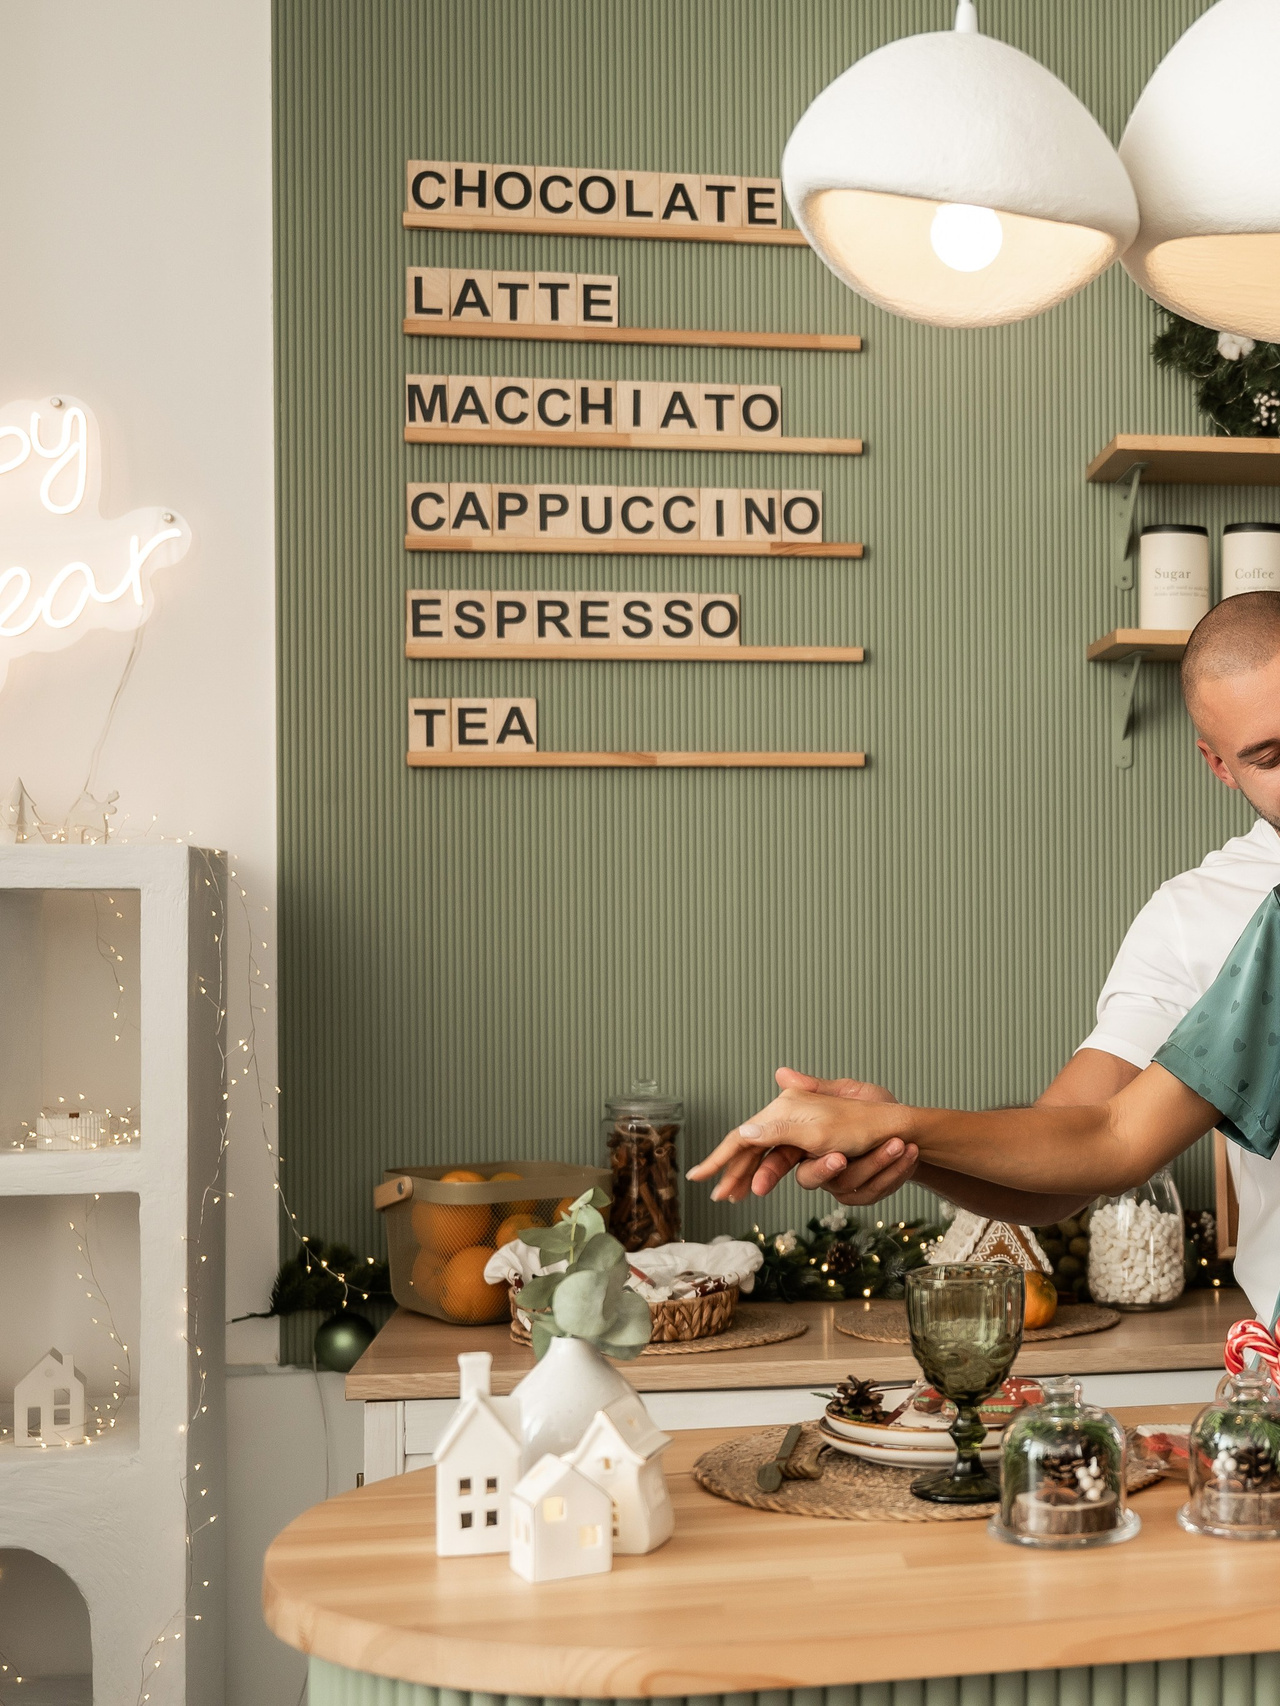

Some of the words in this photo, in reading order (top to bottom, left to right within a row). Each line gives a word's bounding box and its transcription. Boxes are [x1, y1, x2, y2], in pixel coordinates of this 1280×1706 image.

[411, 168, 778, 226] CHOCOLATE
[413, 275, 614, 323] LATTE
[407, 383, 780, 433] MACCHIATO
[410, 490, 821, 536] CAPPUCCINO
[1154, 567, 1192, 582] Sugar
[1234, 567, 1275, 580] Coffee
[411, 598, 739, 640] ESPRESSO
[413, 706, 535, 748] TEA
